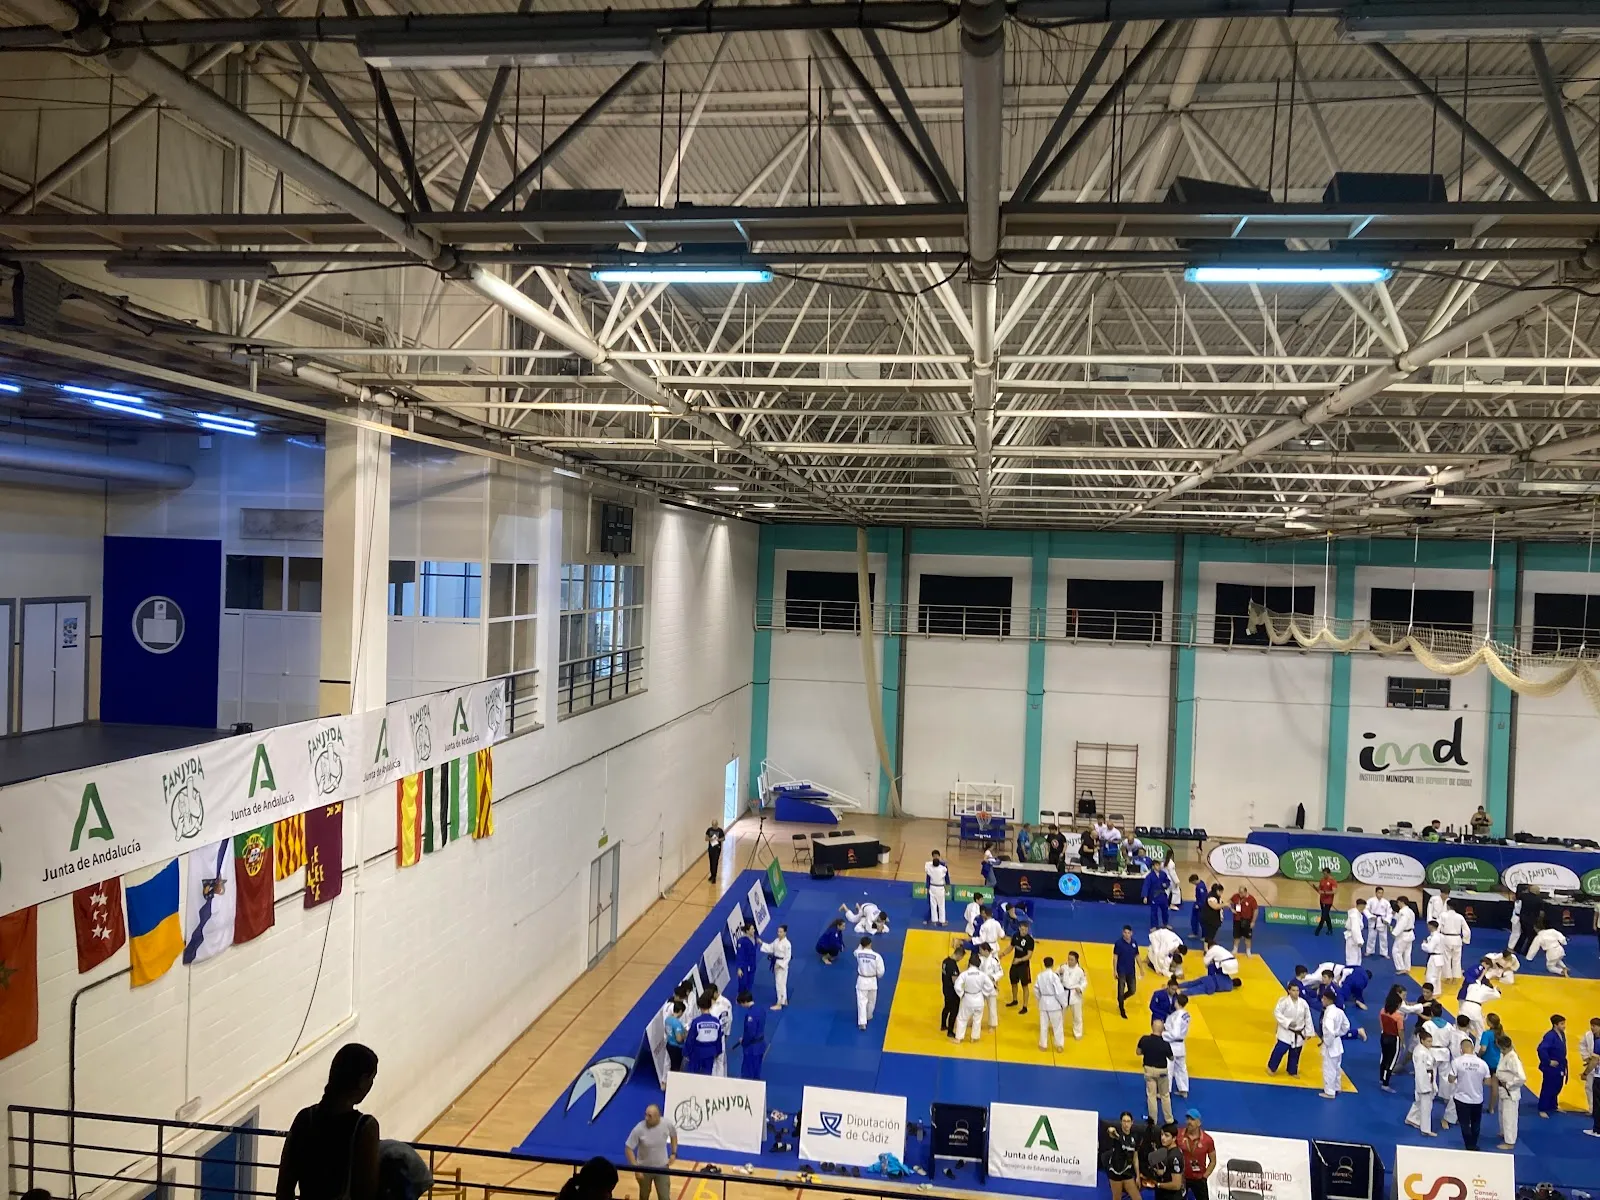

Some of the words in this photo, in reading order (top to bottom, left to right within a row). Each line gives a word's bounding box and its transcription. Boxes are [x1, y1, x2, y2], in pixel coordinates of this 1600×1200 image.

[308, 725, 345, 764] FANJYDA
[456, 740, 461, 748] de
[162, 755, 205, 804] FANJYDA
[1386, 774, 1414, 784] MUNICIPAL
[230, 806, 252, 821] Junta
[253, 802, 262, 813] de
[263, 791, 295, 809] Andalucía
[42, 863, 74, 882] Junta
[77, 855, 90, 871] de
[92, 839, 141, 867] Andalucía
[1374, 856, 1405, 872] FANJYDA
[1449, 861, 1480, 878] FANJYDA
[1528, 867, 1559, 883] FANJYDA
[705, 1095, 753, 1121] FANJYDA
[847, 1113, 900, 1130] Diputación
[846, 1130, 858, 1141] de
[862, 1130, 889, 1145] Cádiz
[1004, 1150, 1026, 1160] Junta
[1028, 1153, 1038, 1161] de
[1040, 1154, 1080, 1165] Andalucía
[1236, 1179, 1247, 1188] de
[1248, 1180, 1273, 1191] Cádiz
[1473, 1189, 1498, 1199] Consejo
